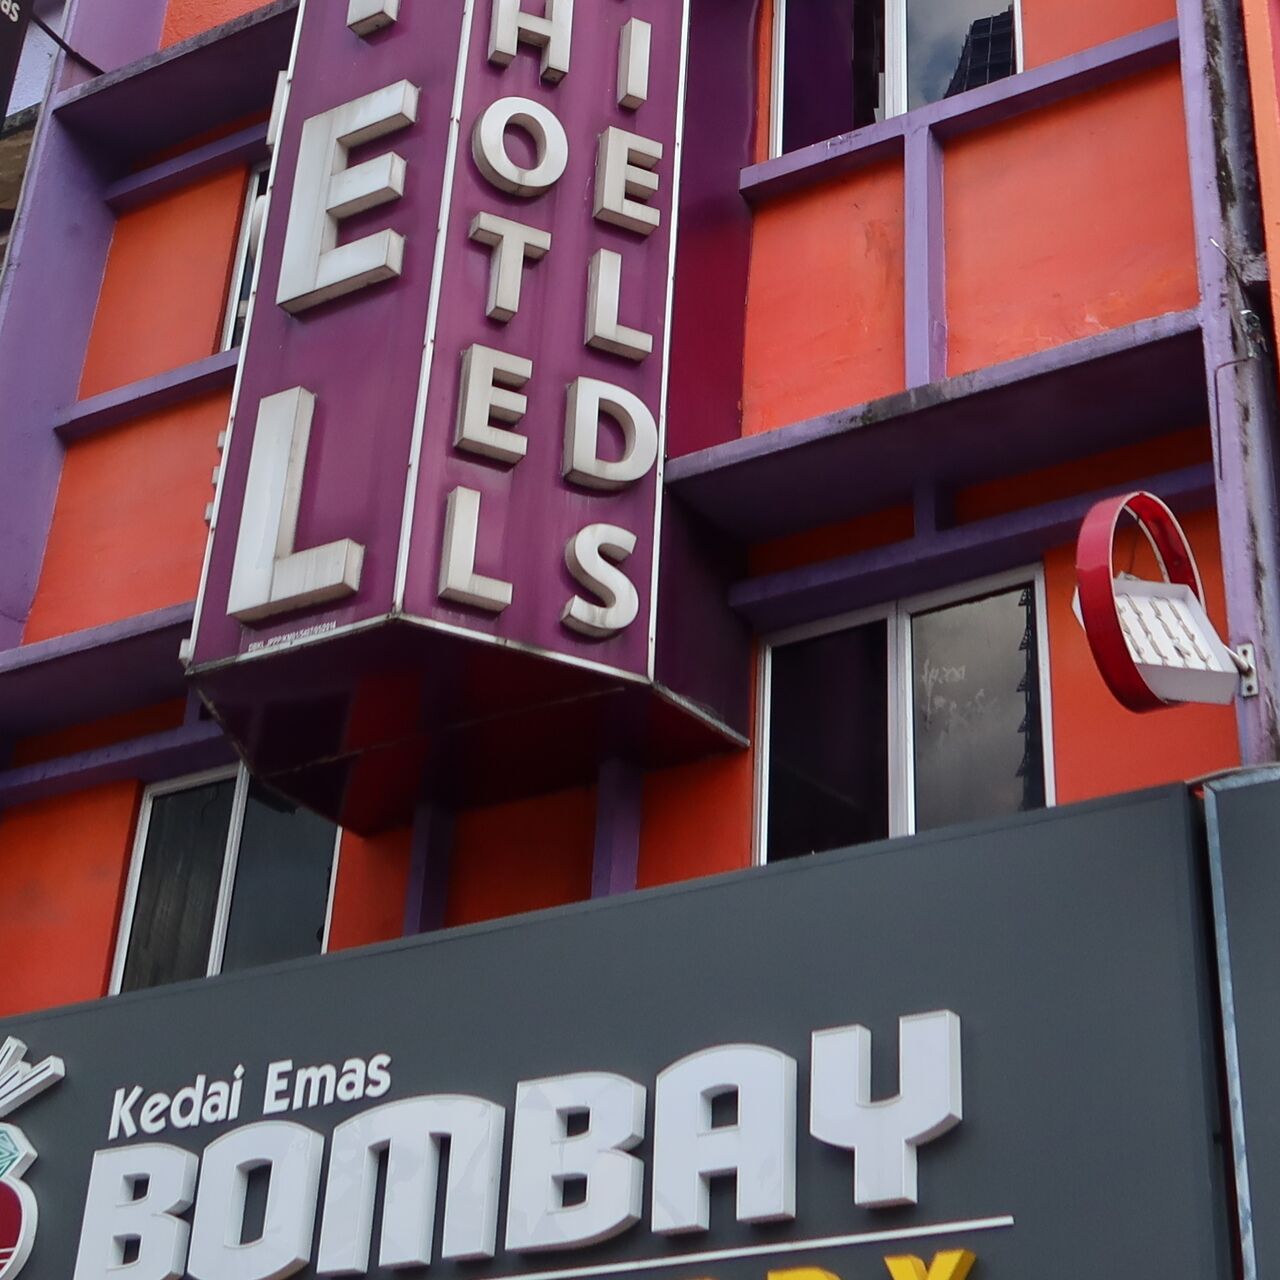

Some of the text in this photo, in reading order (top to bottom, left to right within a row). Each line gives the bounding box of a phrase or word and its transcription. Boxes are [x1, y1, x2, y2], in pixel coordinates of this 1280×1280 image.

[73, 1009, 963, 1280] BOMBAY
[107, 1052, 392, 1140] Kedai Emas
